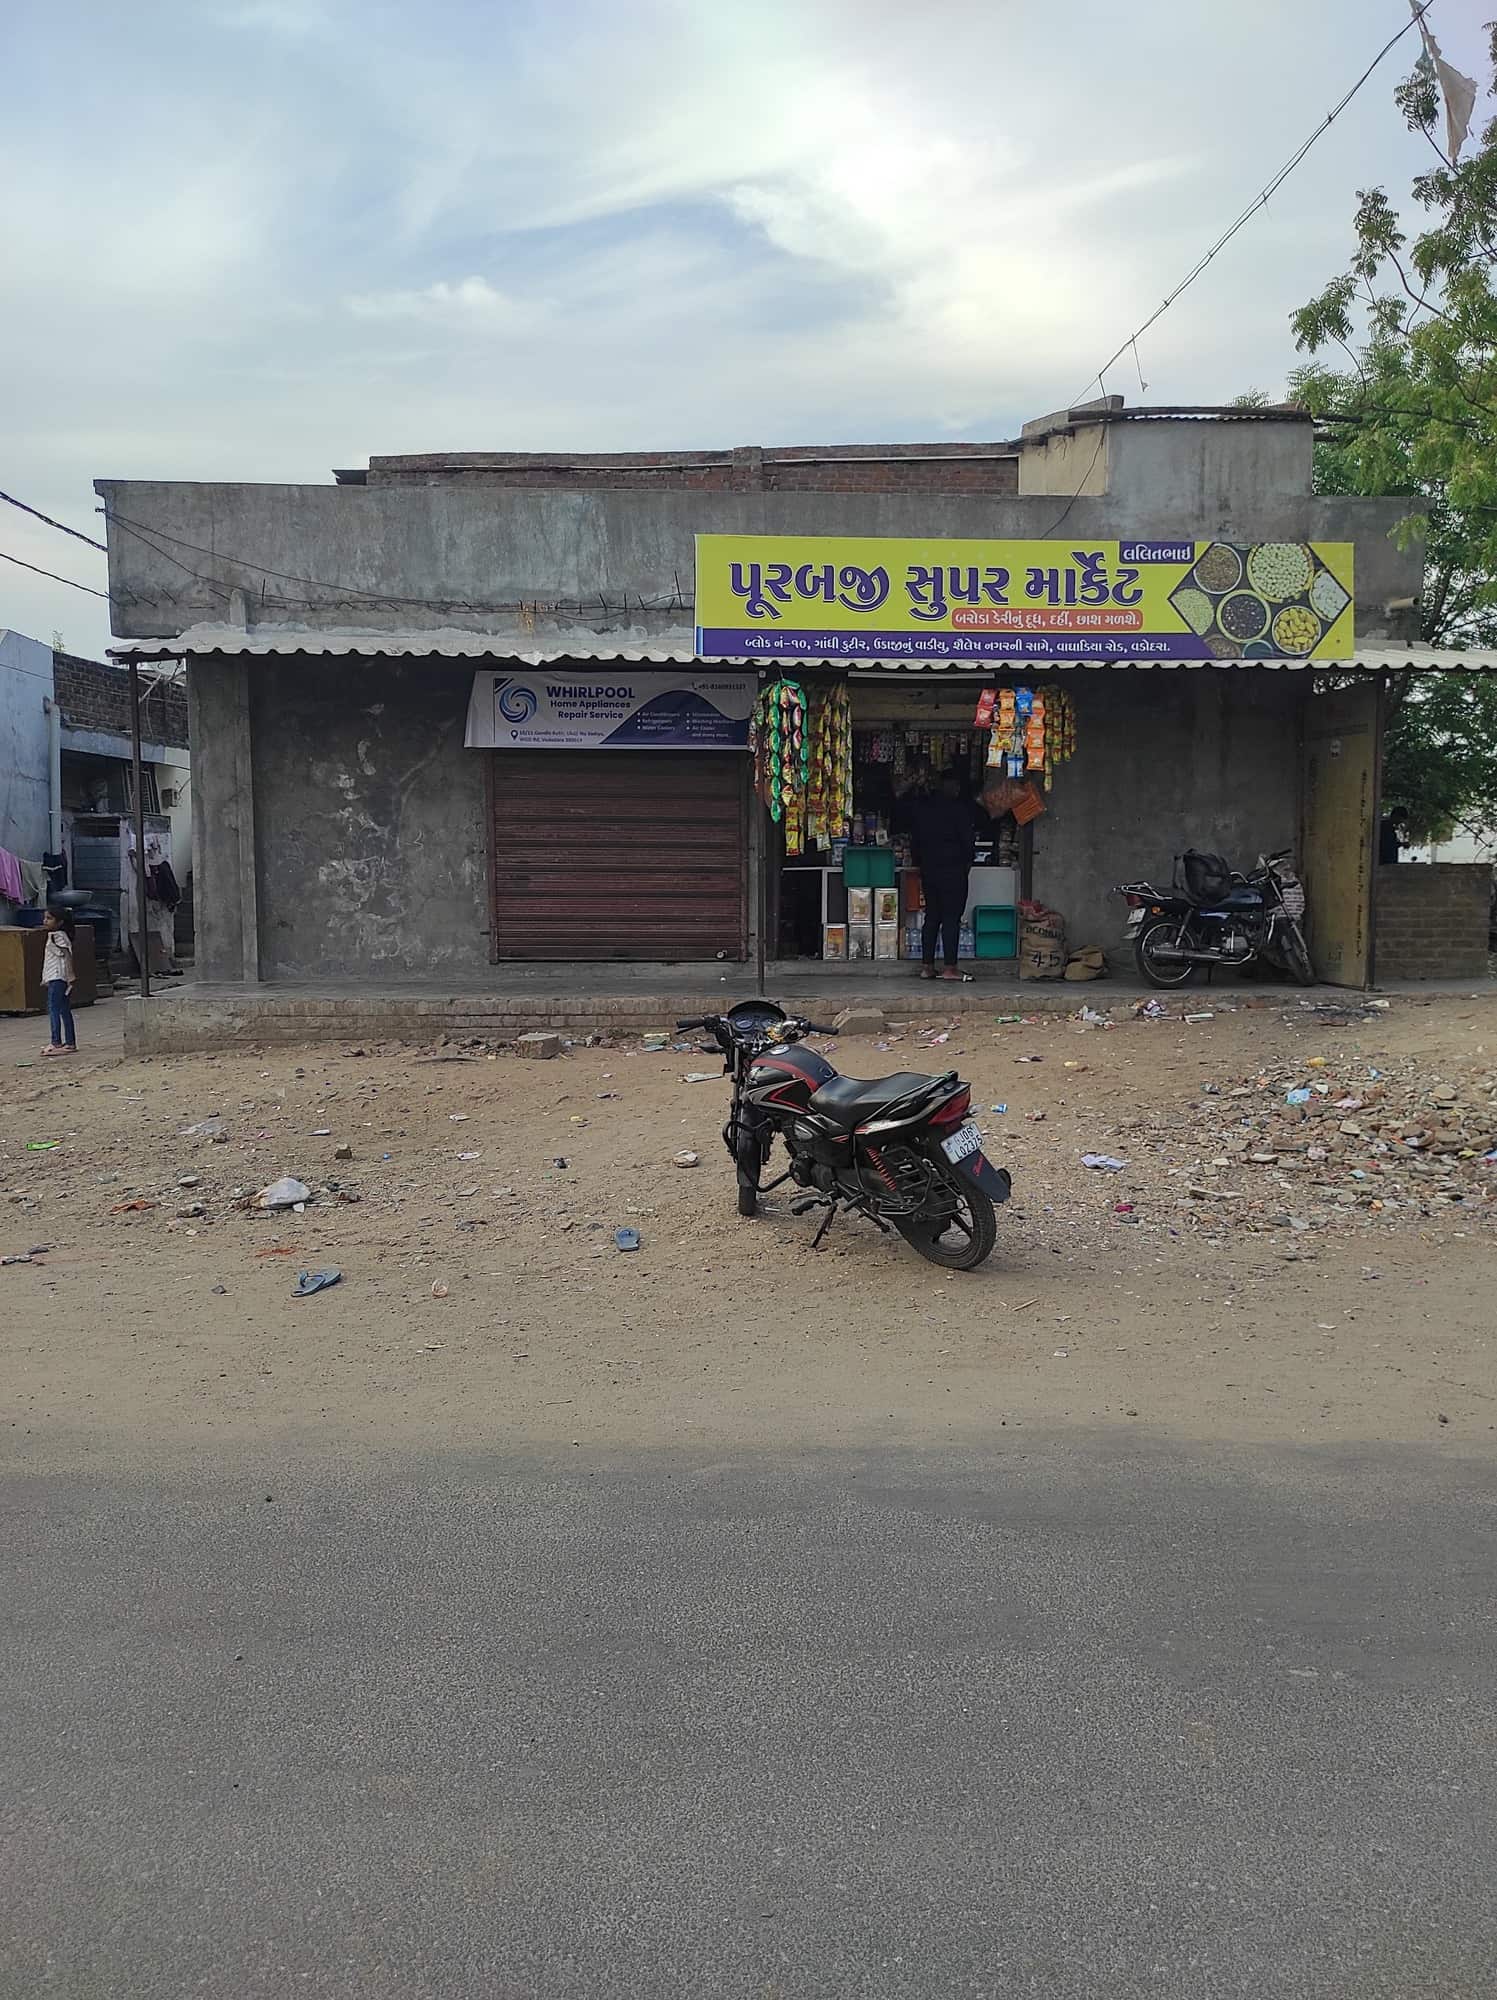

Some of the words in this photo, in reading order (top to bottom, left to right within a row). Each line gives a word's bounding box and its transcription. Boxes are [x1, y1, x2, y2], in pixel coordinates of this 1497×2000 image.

[728, 562, 890, 620] પૂરબજી
[904, 566, 1011, 621] સુપર
[1024, 551, 1144, 607] માર્કેટ
[955, 609, 989, 624] બરોડા
[814, 636, 839, 649] ગાંધી
[984, 638, 1022, 651] નગરની
[546, 686, 635, 699] WHIRLPOOL
[550, 700, 578, 708] Home
[579, 700, 631, 710] Appliances
[558, 711, 588, 720] Repair
[590, 711, 624, 719] Service
